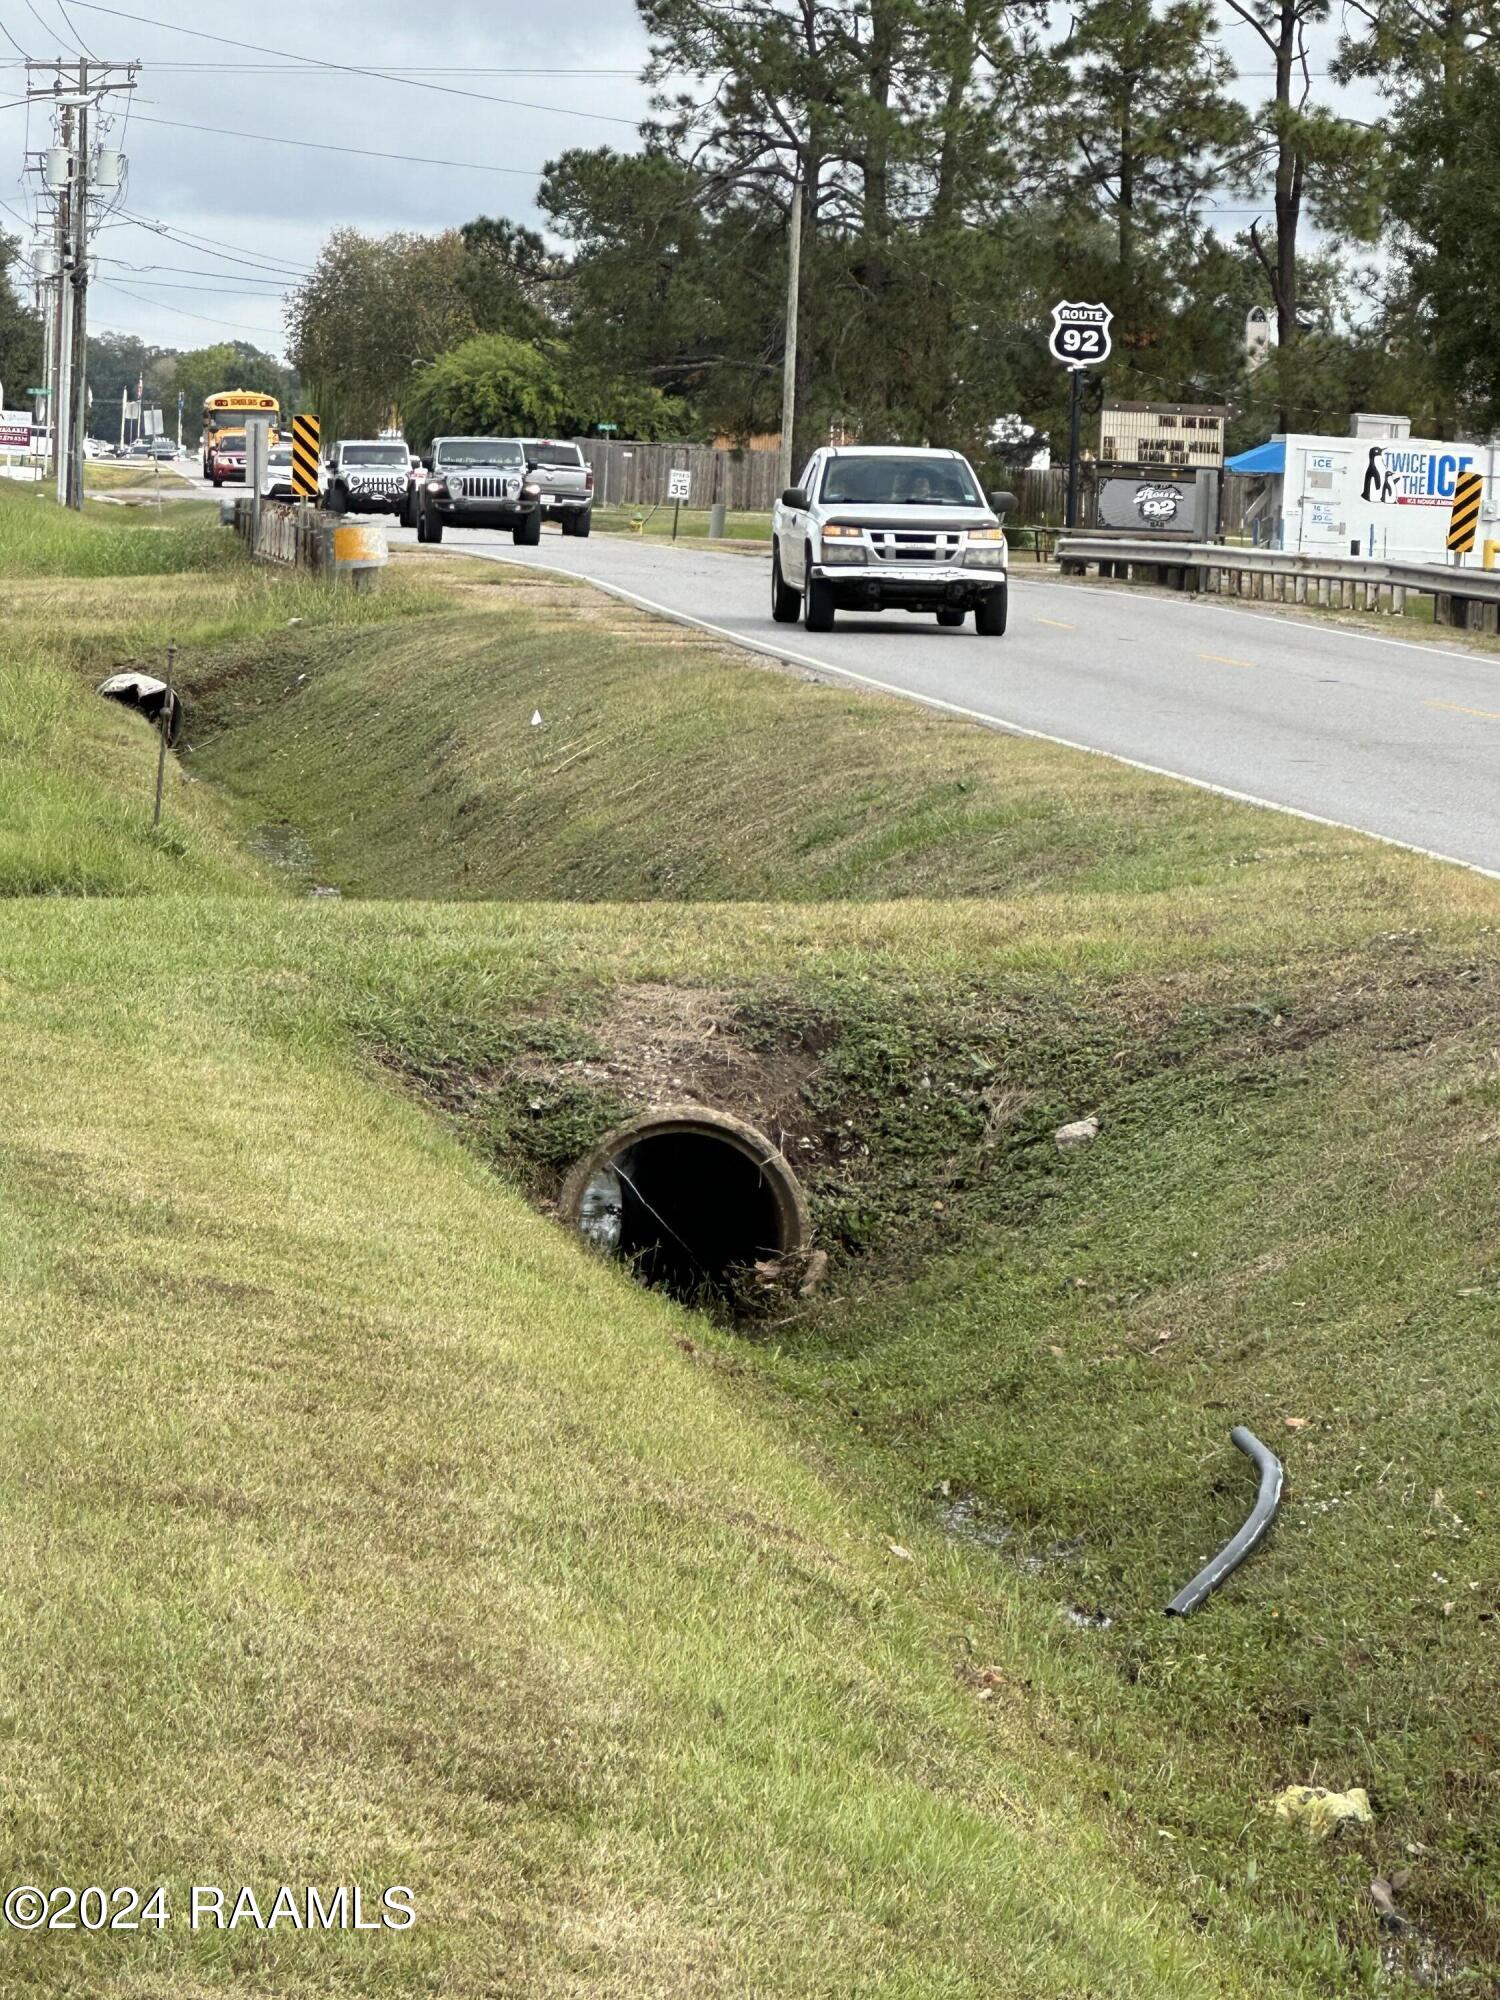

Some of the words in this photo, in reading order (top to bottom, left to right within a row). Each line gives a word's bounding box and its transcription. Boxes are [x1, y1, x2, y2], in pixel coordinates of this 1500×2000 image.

[1061, 309, 1103, 321] ROUTE
[1063, 329, 1099, 352] 92
[1313, 459, 1332, 468] ICE
[1384, 452, 1427, 473] TWICE
[671, 484, 688, 495] 35
[1402, 475, 1426, 495] THE
[1143, 500, 1176, 516] 92
